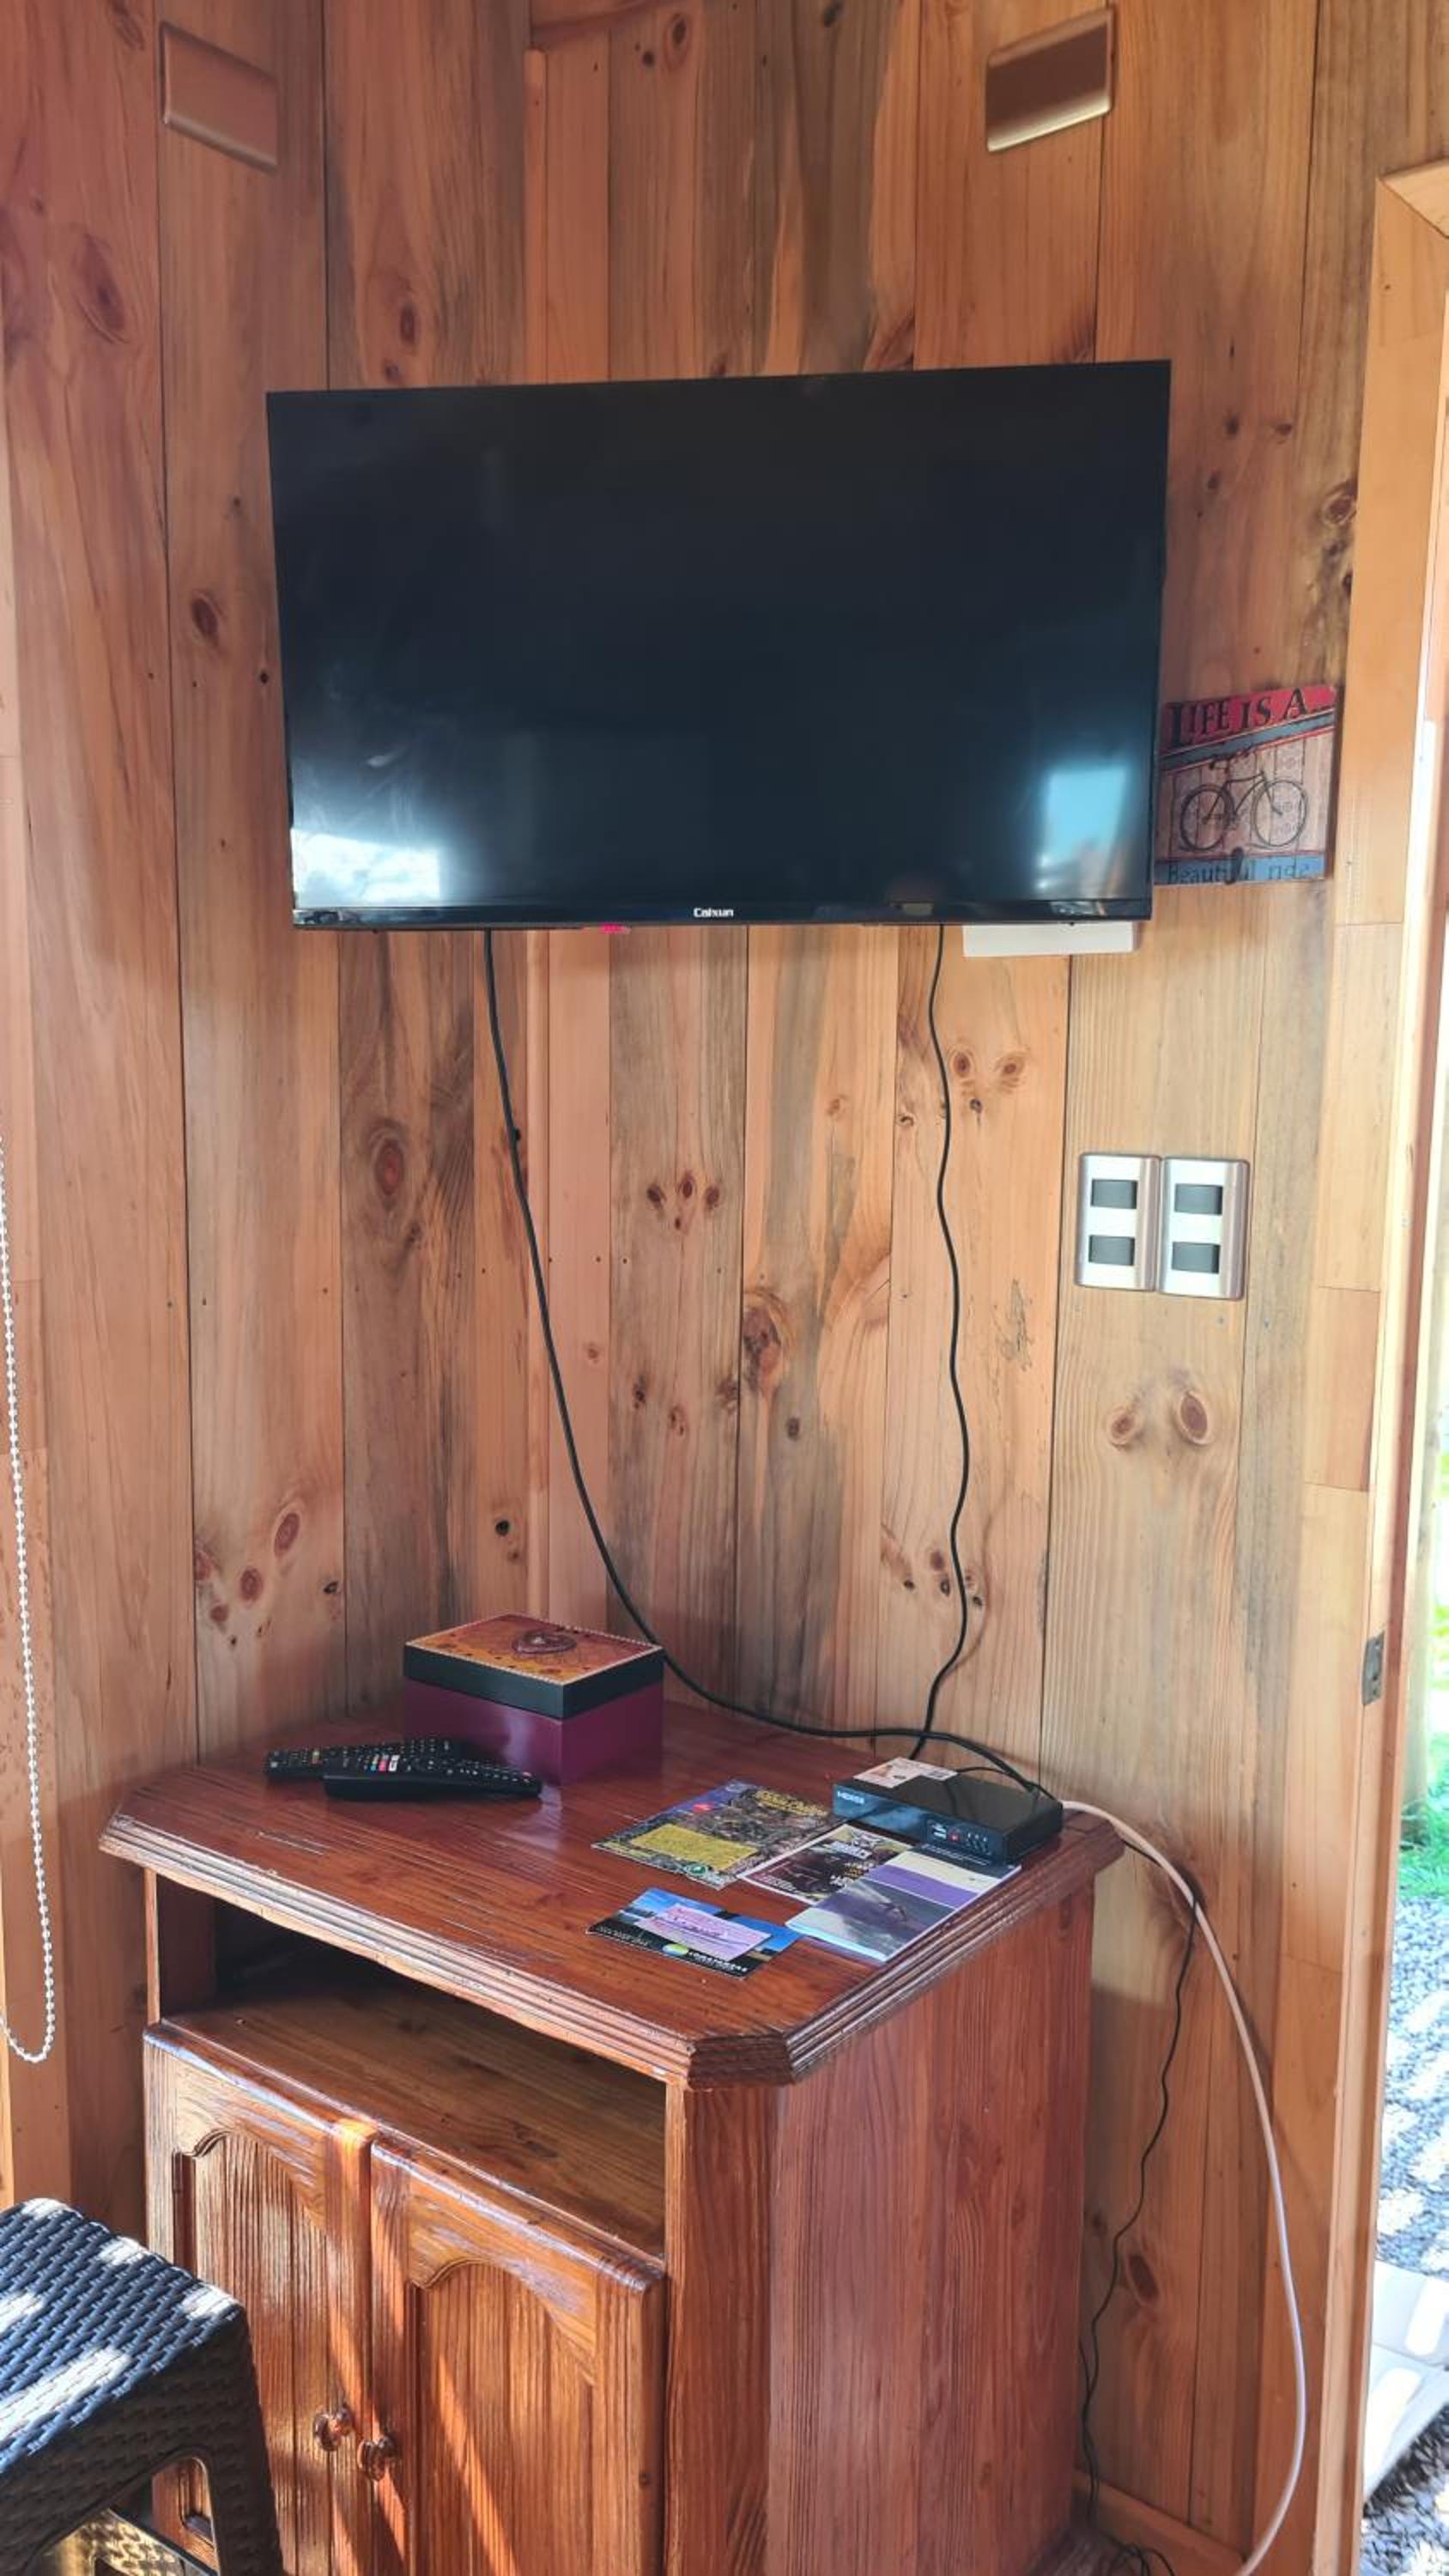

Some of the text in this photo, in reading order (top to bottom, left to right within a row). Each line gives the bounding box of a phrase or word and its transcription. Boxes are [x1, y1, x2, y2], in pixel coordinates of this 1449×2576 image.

[1167, 688, 1309, 747] LIFE IS A
